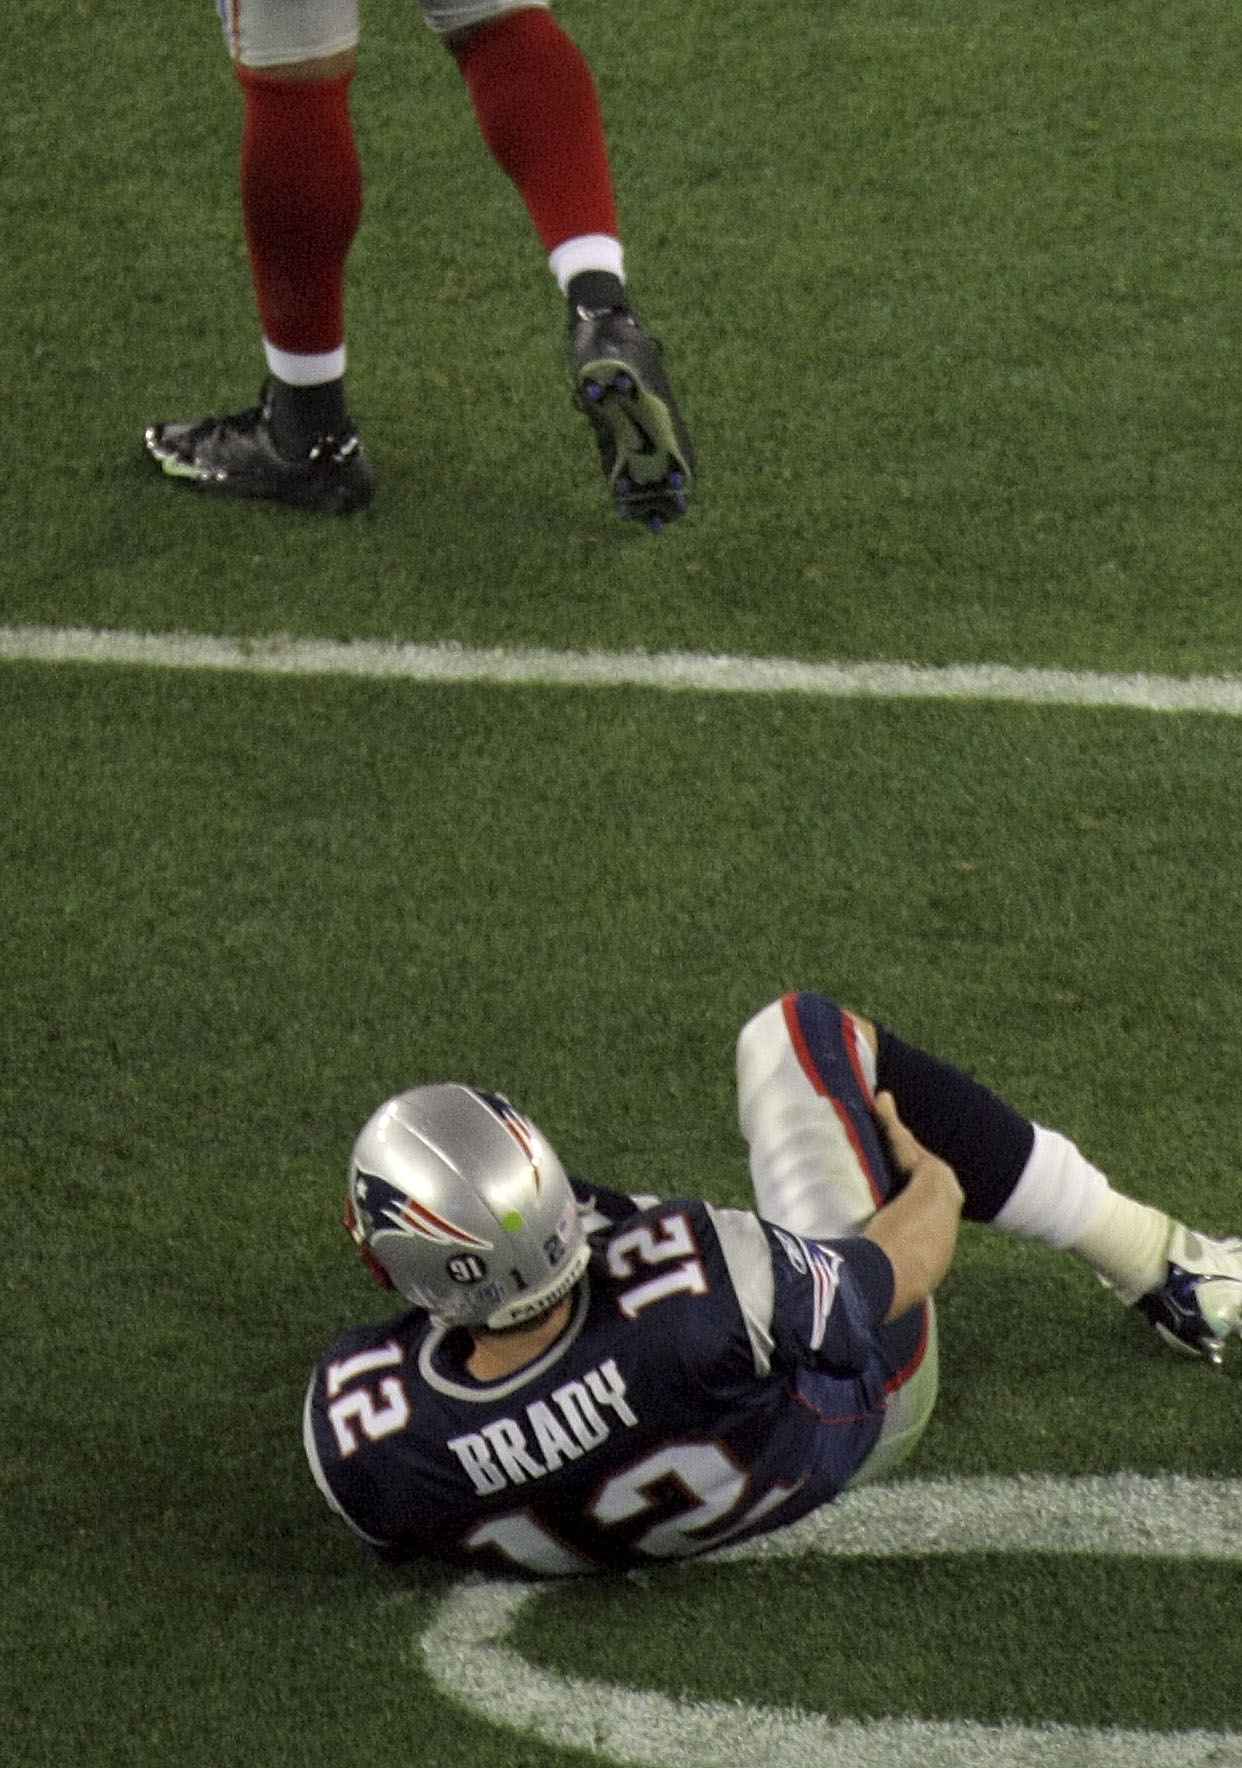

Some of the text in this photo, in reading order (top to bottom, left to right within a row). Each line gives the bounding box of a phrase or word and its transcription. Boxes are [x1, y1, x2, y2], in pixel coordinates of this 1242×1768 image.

[450, 1255, 485, 1284] 91
[606, 1213, 708, 1320] 12
[323, 1340, 409, 1458] 12
[447, 1358, 639, 1497] BRADY
[460, 1442, 807, 1576] 12
